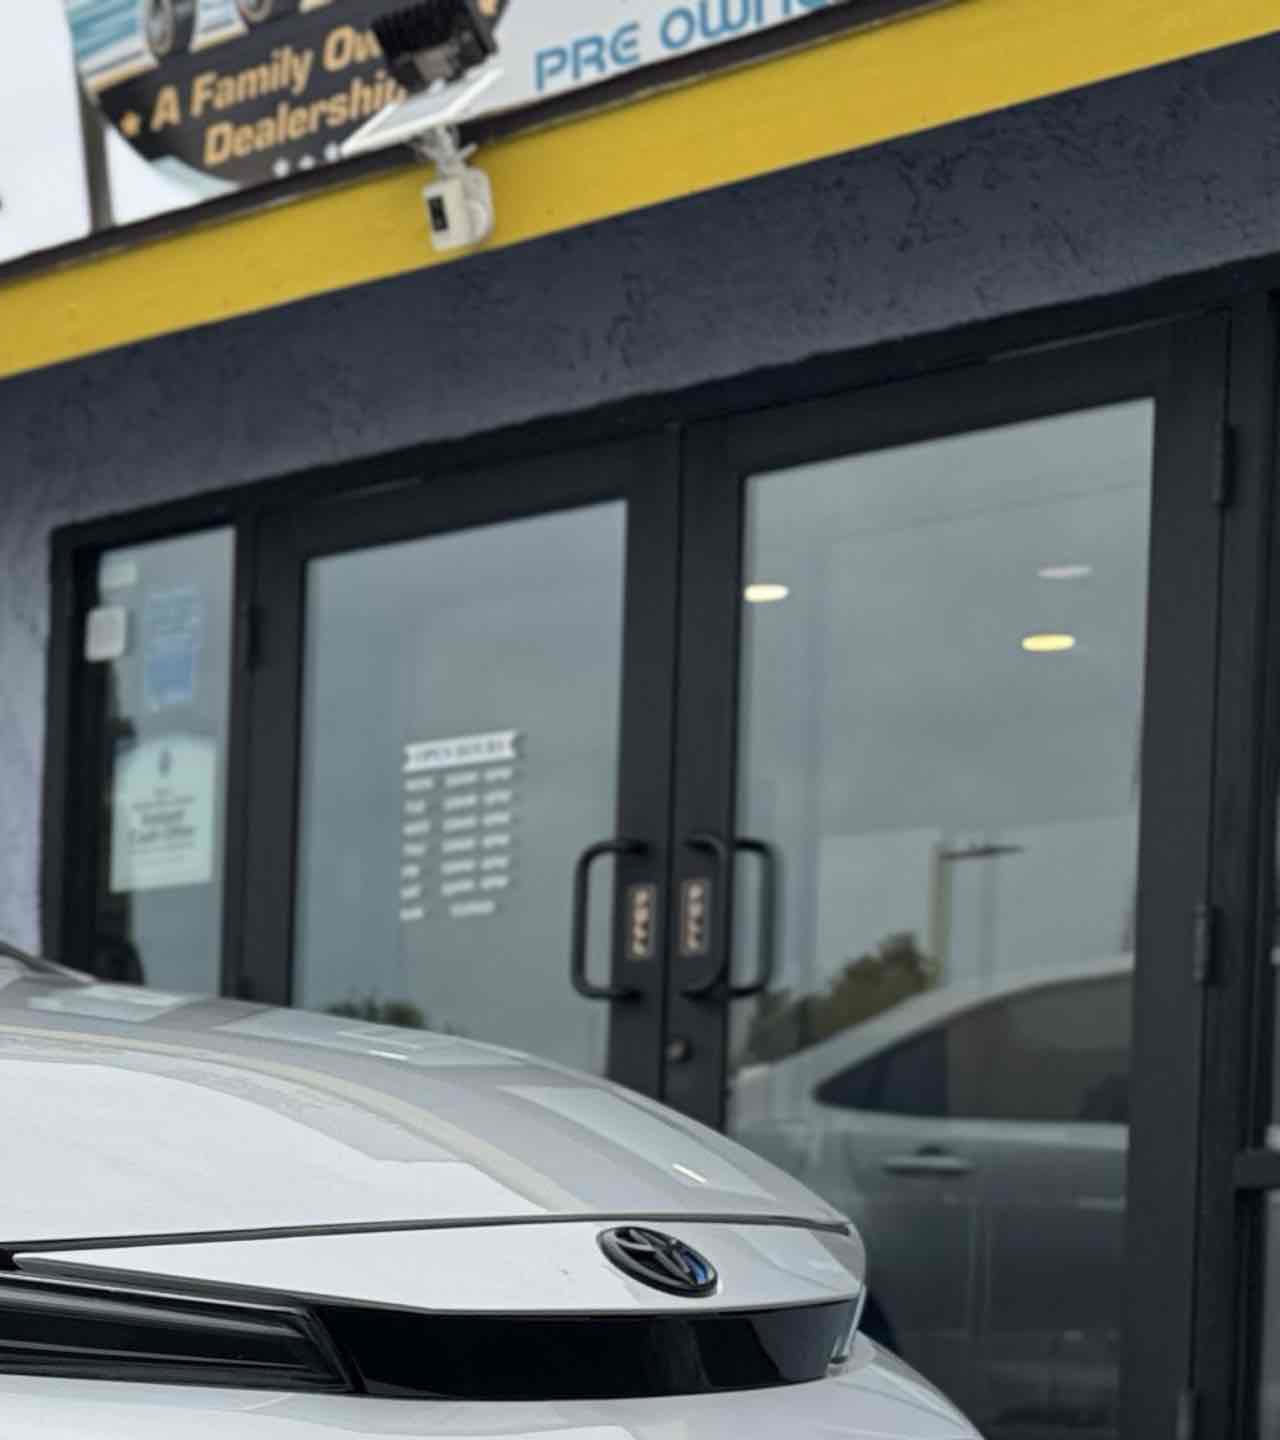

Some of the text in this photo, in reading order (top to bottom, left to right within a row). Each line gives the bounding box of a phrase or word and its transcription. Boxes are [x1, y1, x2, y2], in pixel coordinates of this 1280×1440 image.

[151, 87, 180, 130] A
[190, 47, 312, 118] Family
[535, 23, 639, 89] PRE
